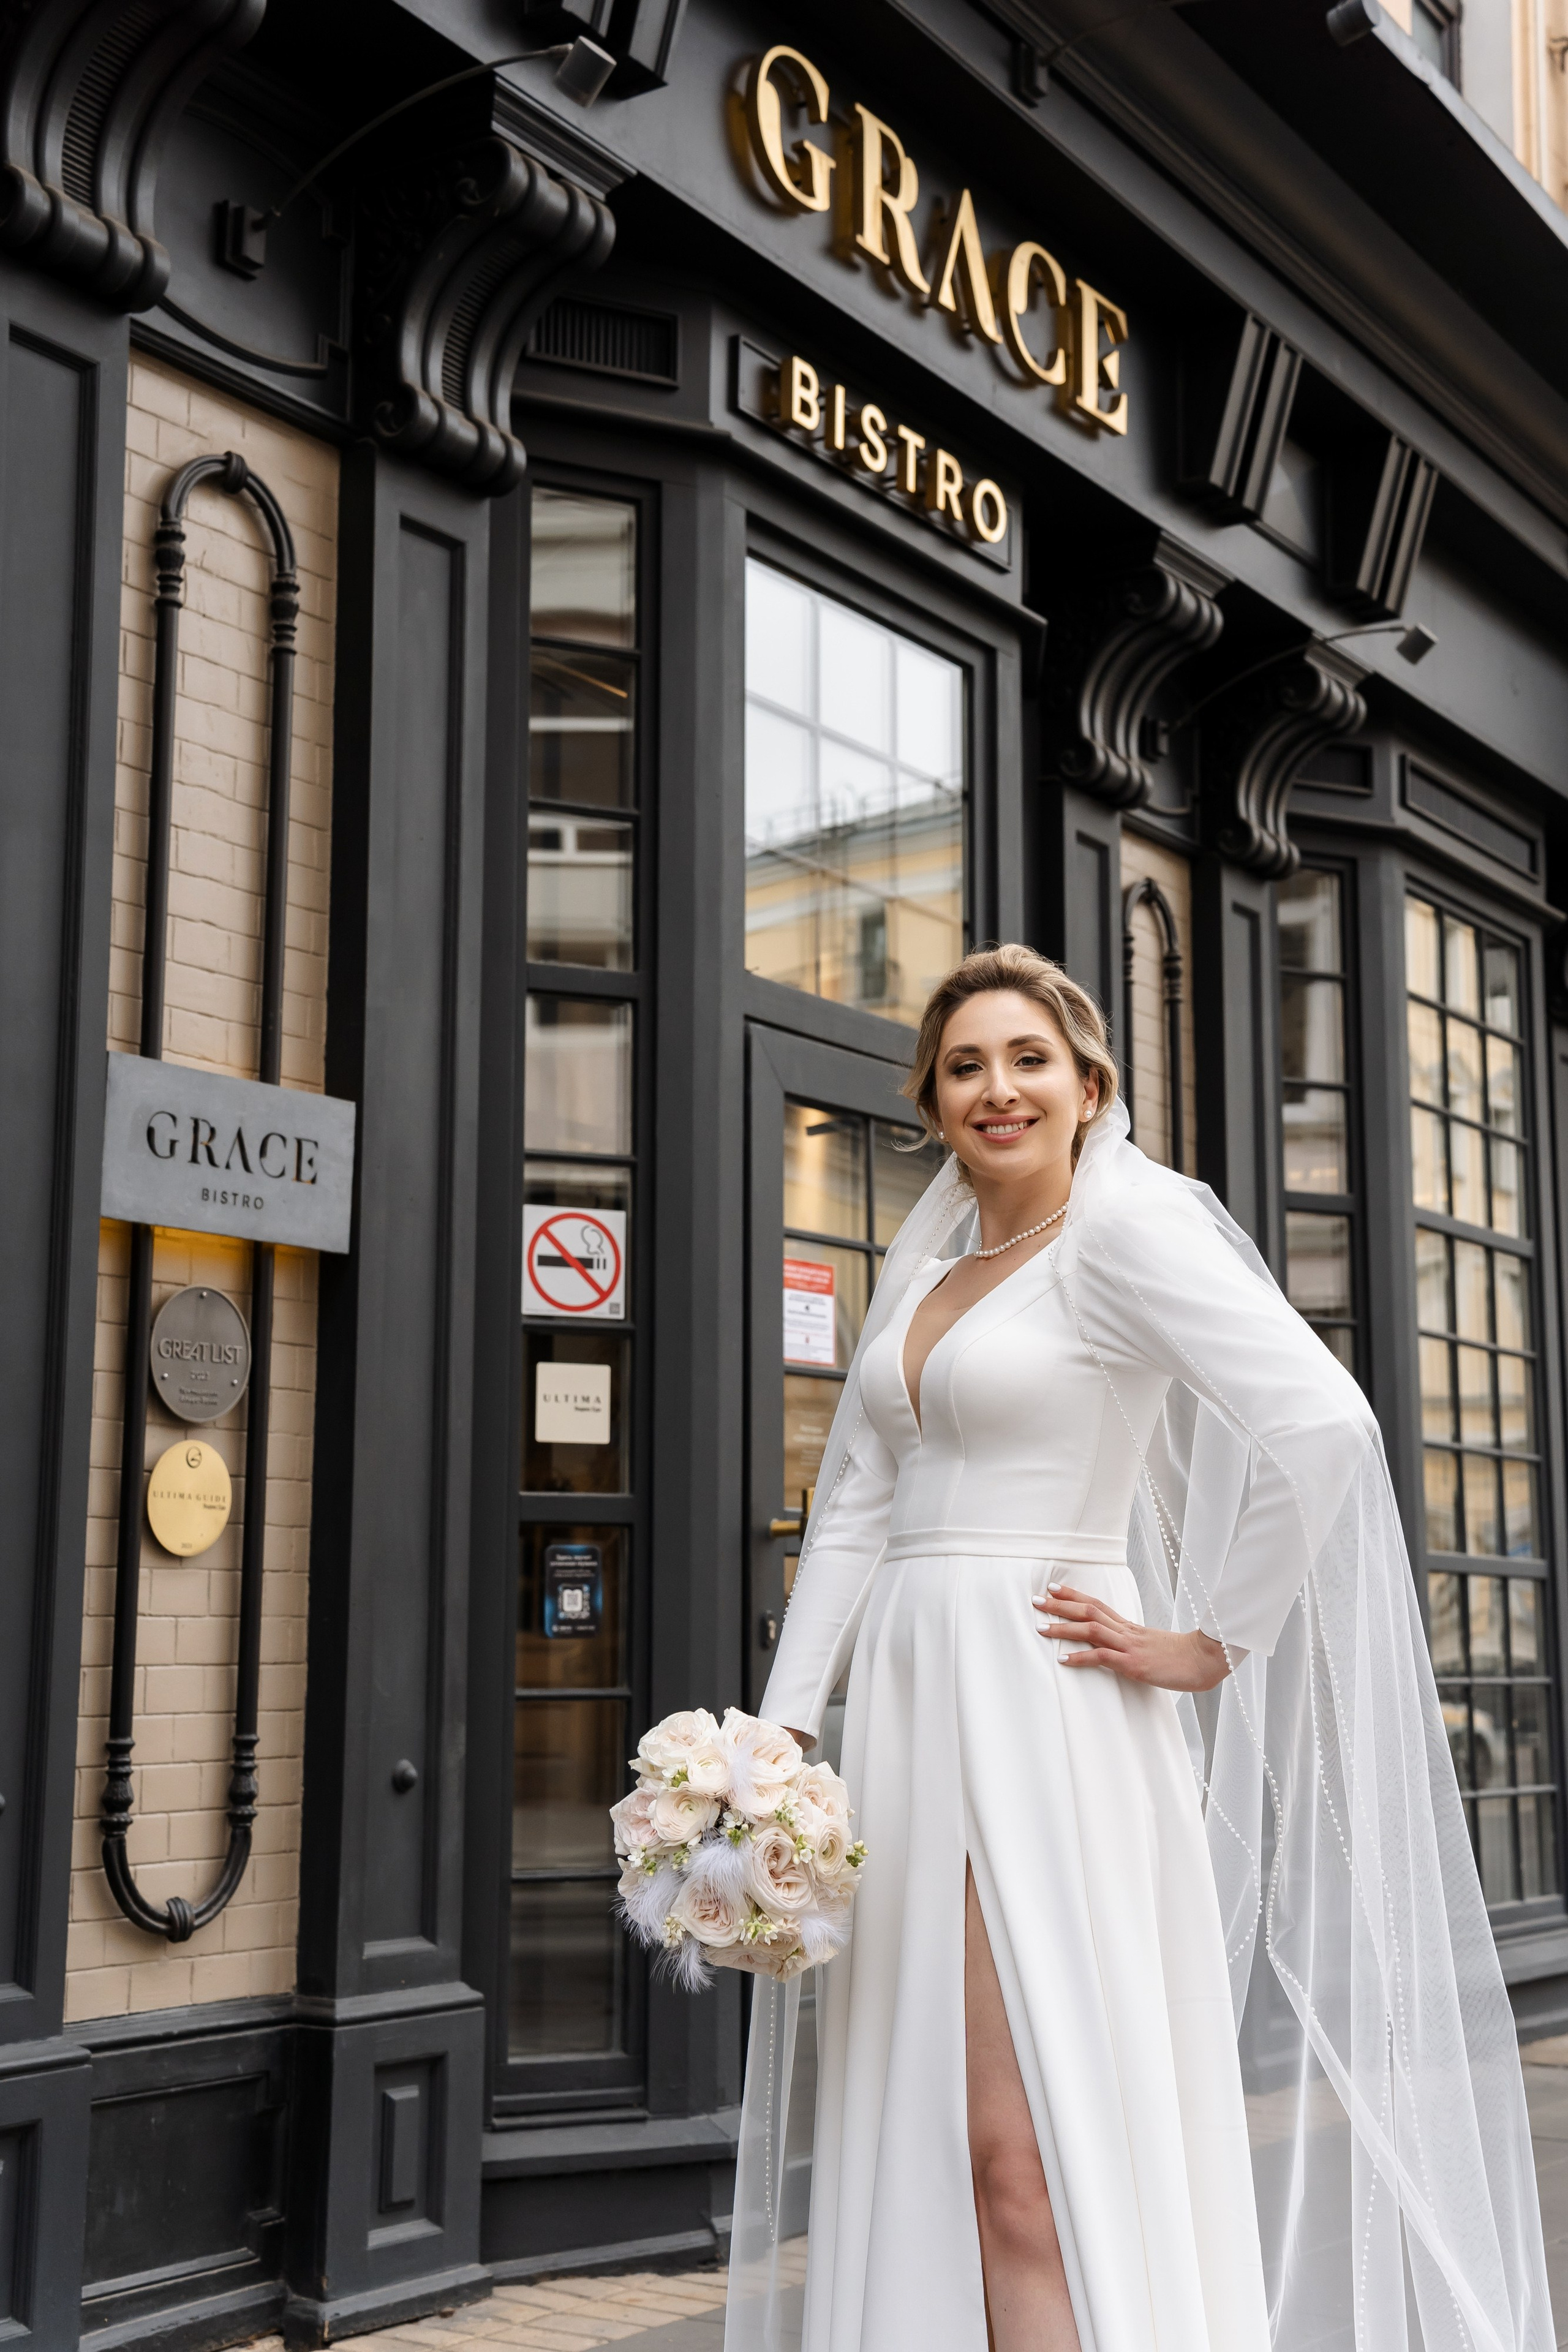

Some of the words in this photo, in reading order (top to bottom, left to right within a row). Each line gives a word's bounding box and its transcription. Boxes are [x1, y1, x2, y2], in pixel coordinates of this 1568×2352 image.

[747, 44, 1129, 437] GRACE
[783, 355, 1008, 544] BISTRO
[146, 1110, 319, 1186] GRACE
[201, 1187, 265, 1211] BISTRO
[543, 1393, 601, 1403] ULTIMA
[153, 1490, 192, 1500] ULTIMA
